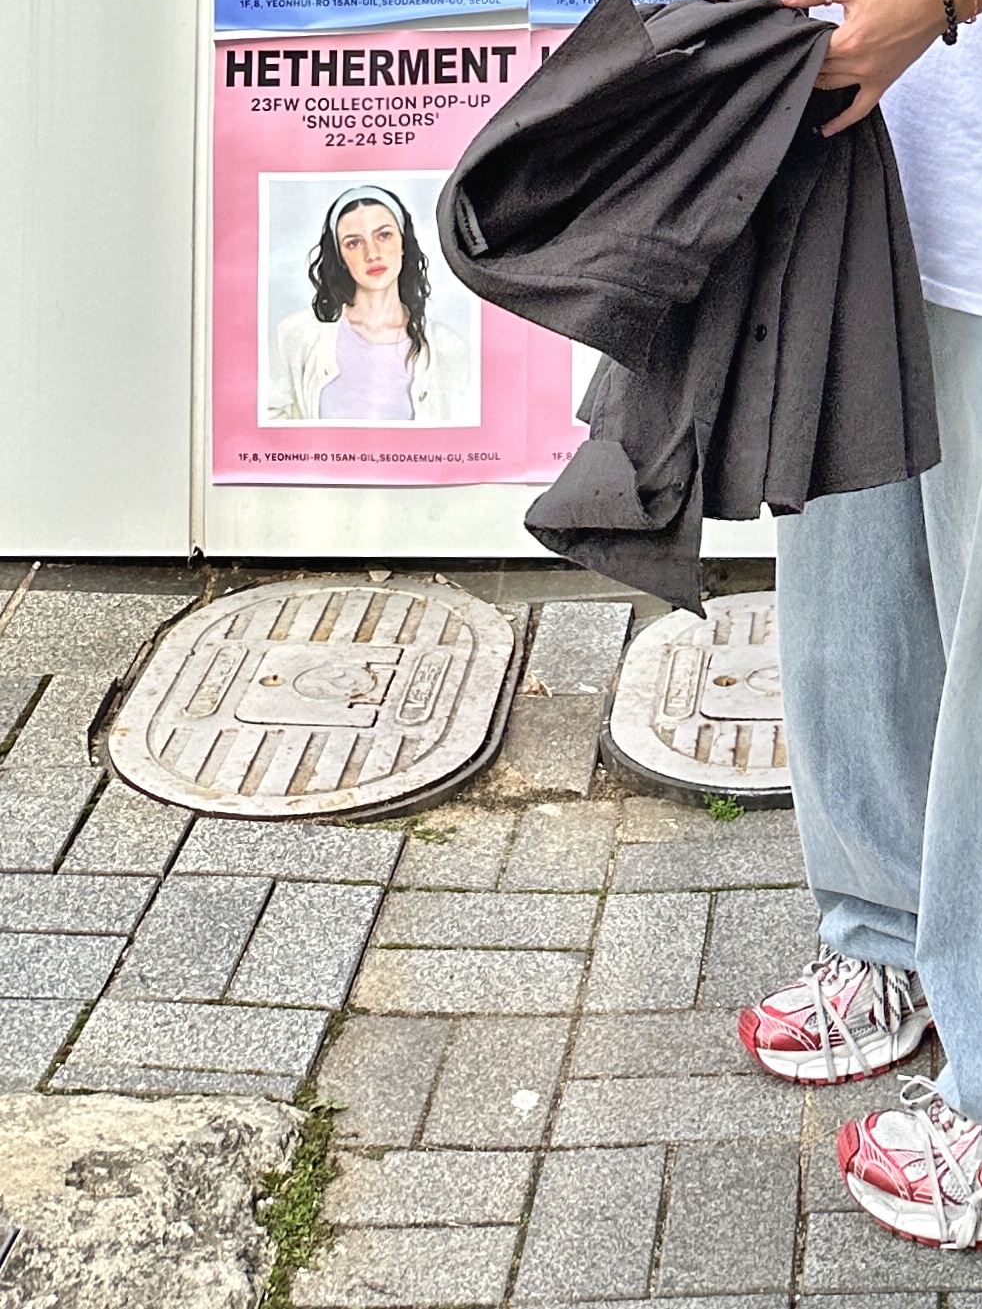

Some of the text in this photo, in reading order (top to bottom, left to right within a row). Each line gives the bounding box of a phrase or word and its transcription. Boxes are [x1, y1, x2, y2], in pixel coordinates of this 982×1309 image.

[226, 46, 516, 87] HETHERMENT
[251, 94, 490, 111] 23FW COLLECTION POP-UP
[302, 112, 438, 128] 'SNUG COLORS'
[325, 131, 415, 146] 22-24 SEP
[467, 452, 500, 461] SEOUL
